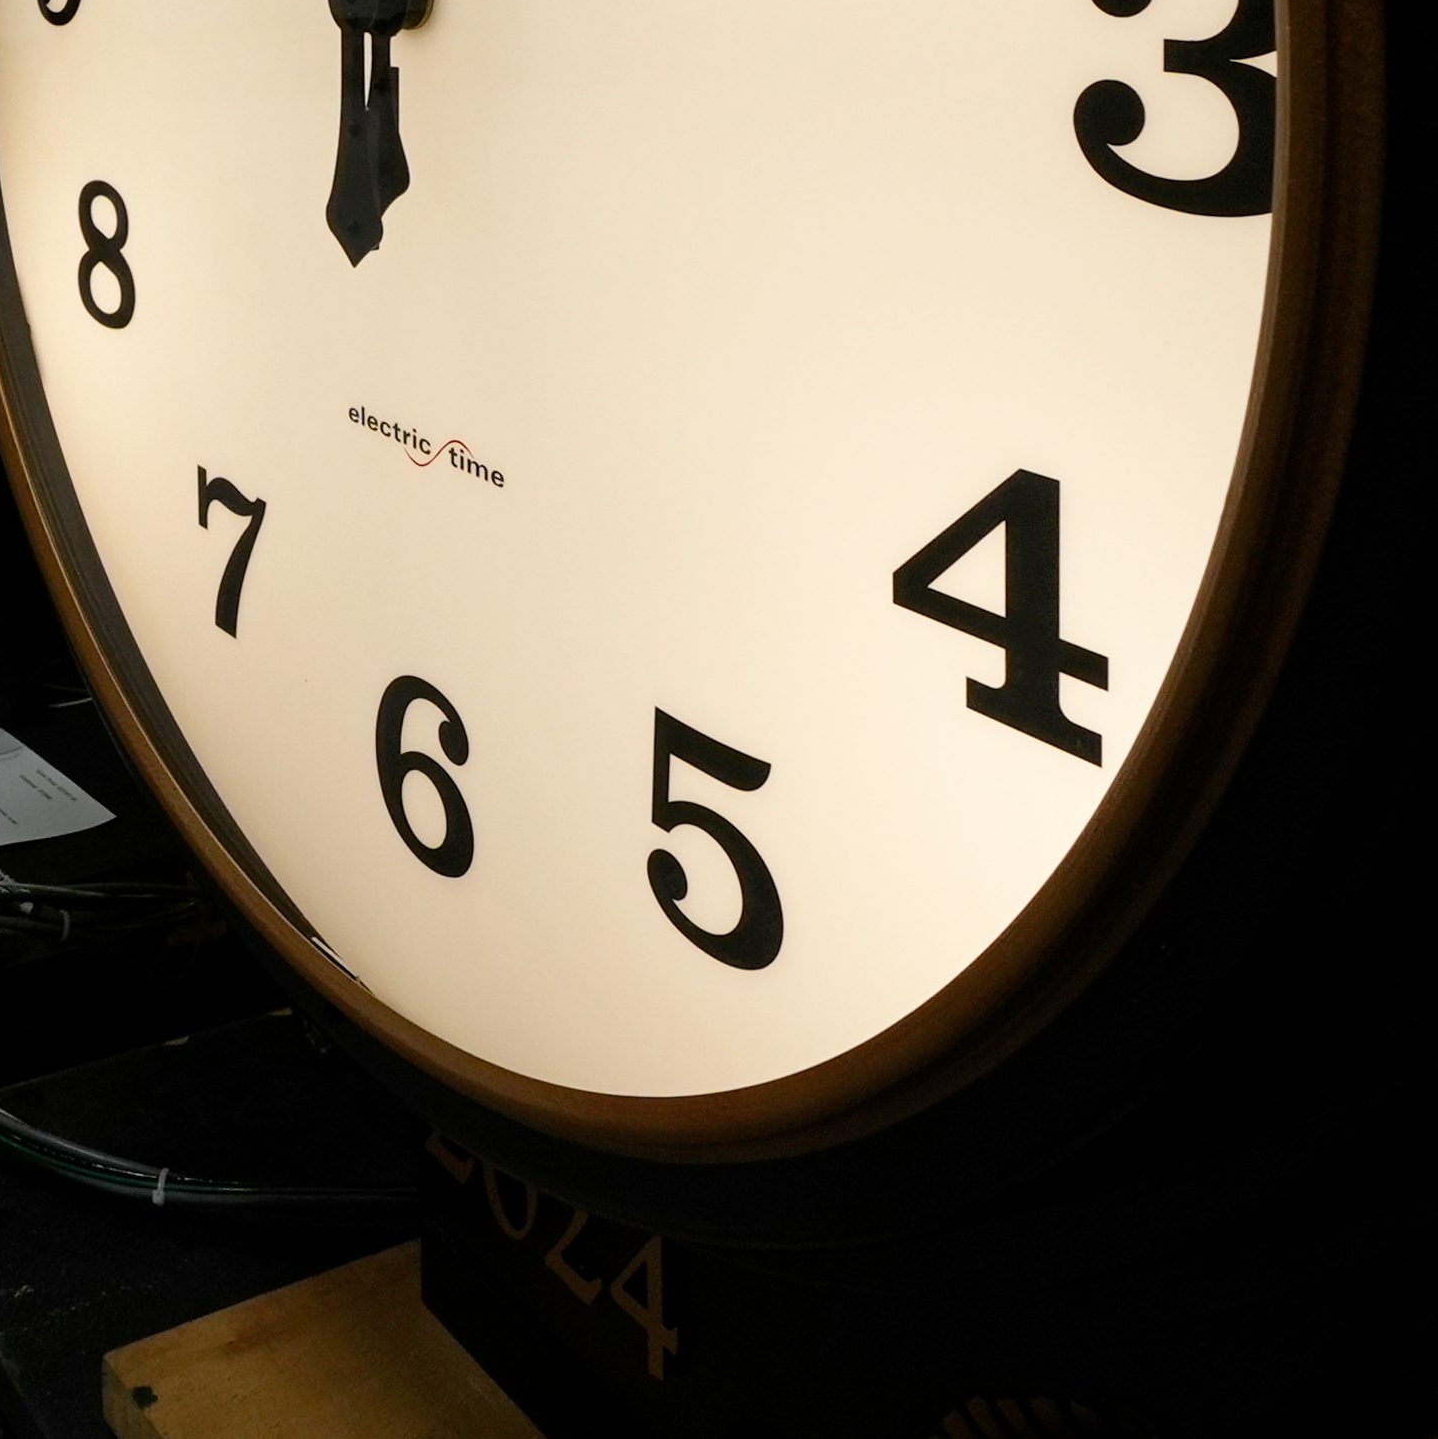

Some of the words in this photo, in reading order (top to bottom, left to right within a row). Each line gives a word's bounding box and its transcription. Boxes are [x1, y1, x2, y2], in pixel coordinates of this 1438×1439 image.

[78, 180, 136, 329] 8
[348, 406, 432, 455] electric
[448, 446, 505, 488] time
[198, 465, 267, 638] 7
[892, 468, 1109, 768] 4
[375, 675, 475, 879] 6
[647, 706, 784, 971] 5
